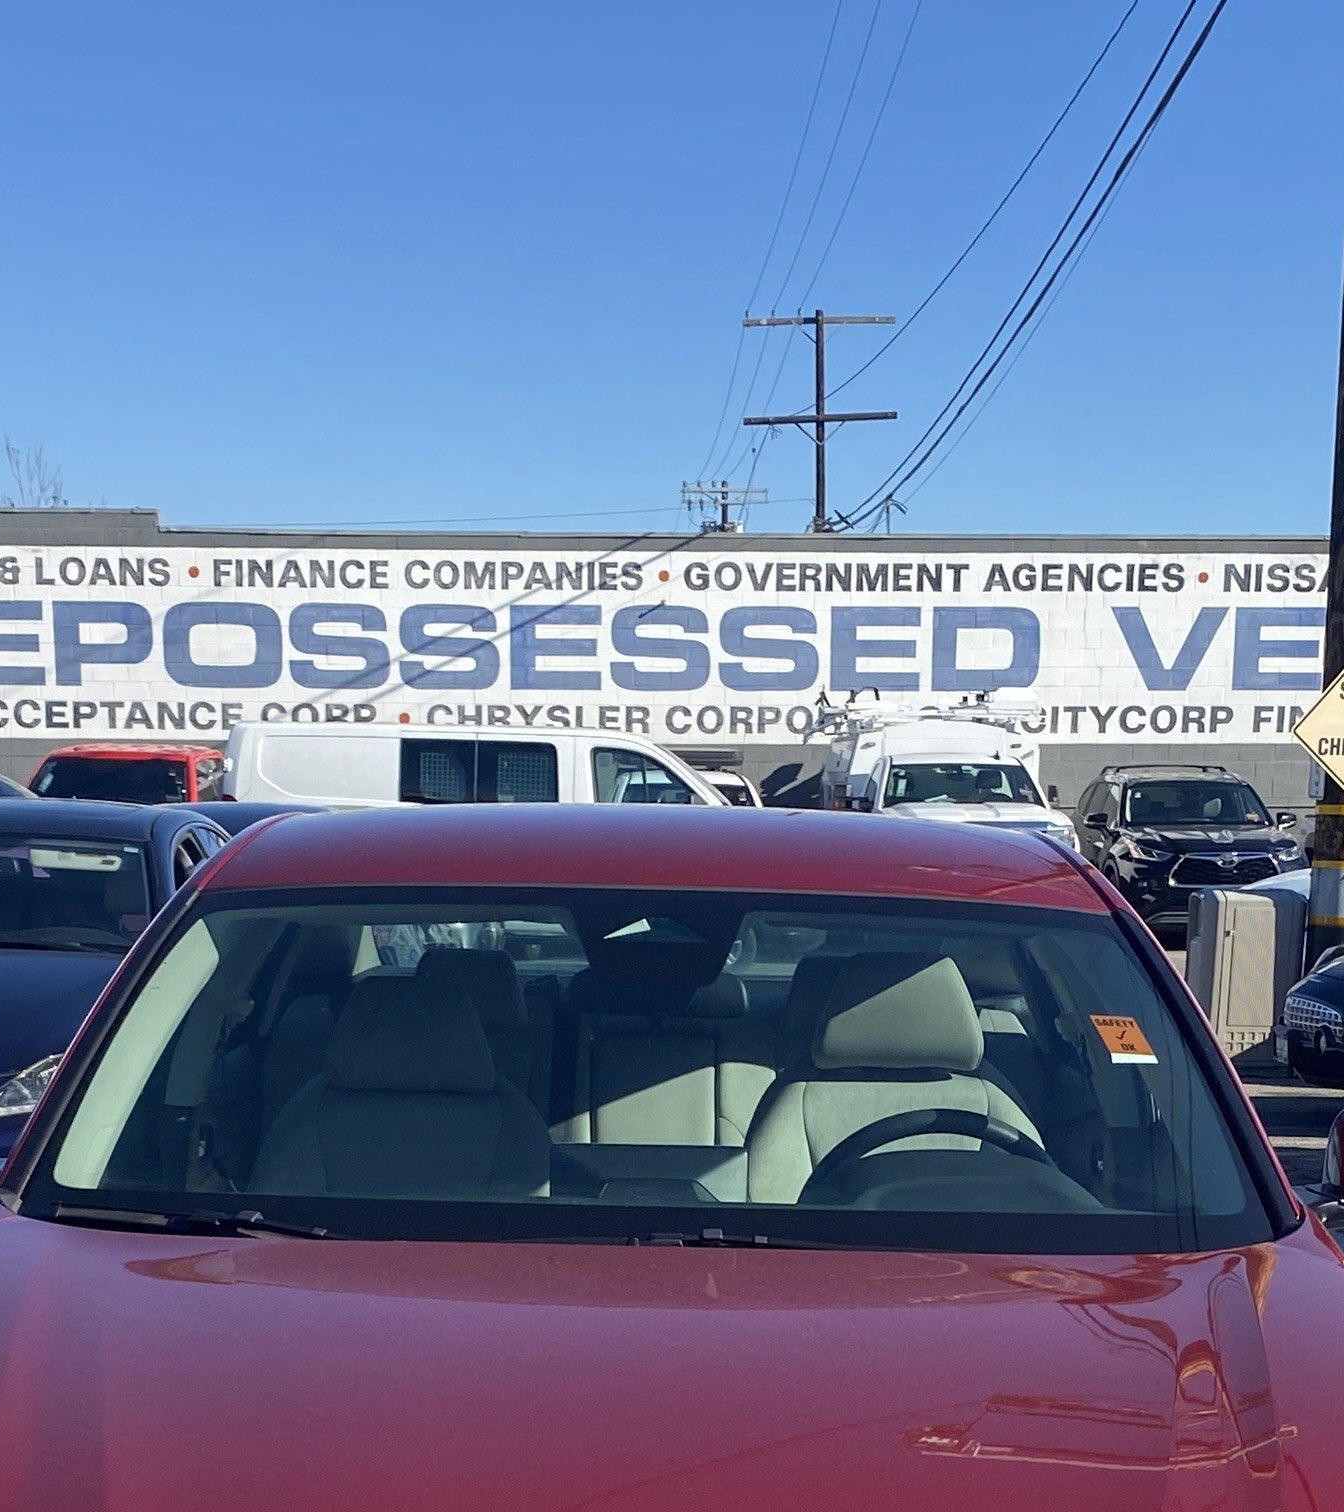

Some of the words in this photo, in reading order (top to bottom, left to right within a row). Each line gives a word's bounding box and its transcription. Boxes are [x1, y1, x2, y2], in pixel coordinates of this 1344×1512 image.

[36, 556, 171, 587] LOANS
[213, 559, 390, 590] FINANCE
[404, 560, 644, 591] COMPANIES
[684, 562, 969, 592] GOVERNMENT
[983, 563, 1185, 593] AGENCIES
[1223, 563, 1329, 593] NISS
[427, 703, 651, 735] CHRYSLER
[1094, 1018, 1135, 1028] SAFETY
[1120, 1043, 1137, 1052] OK
